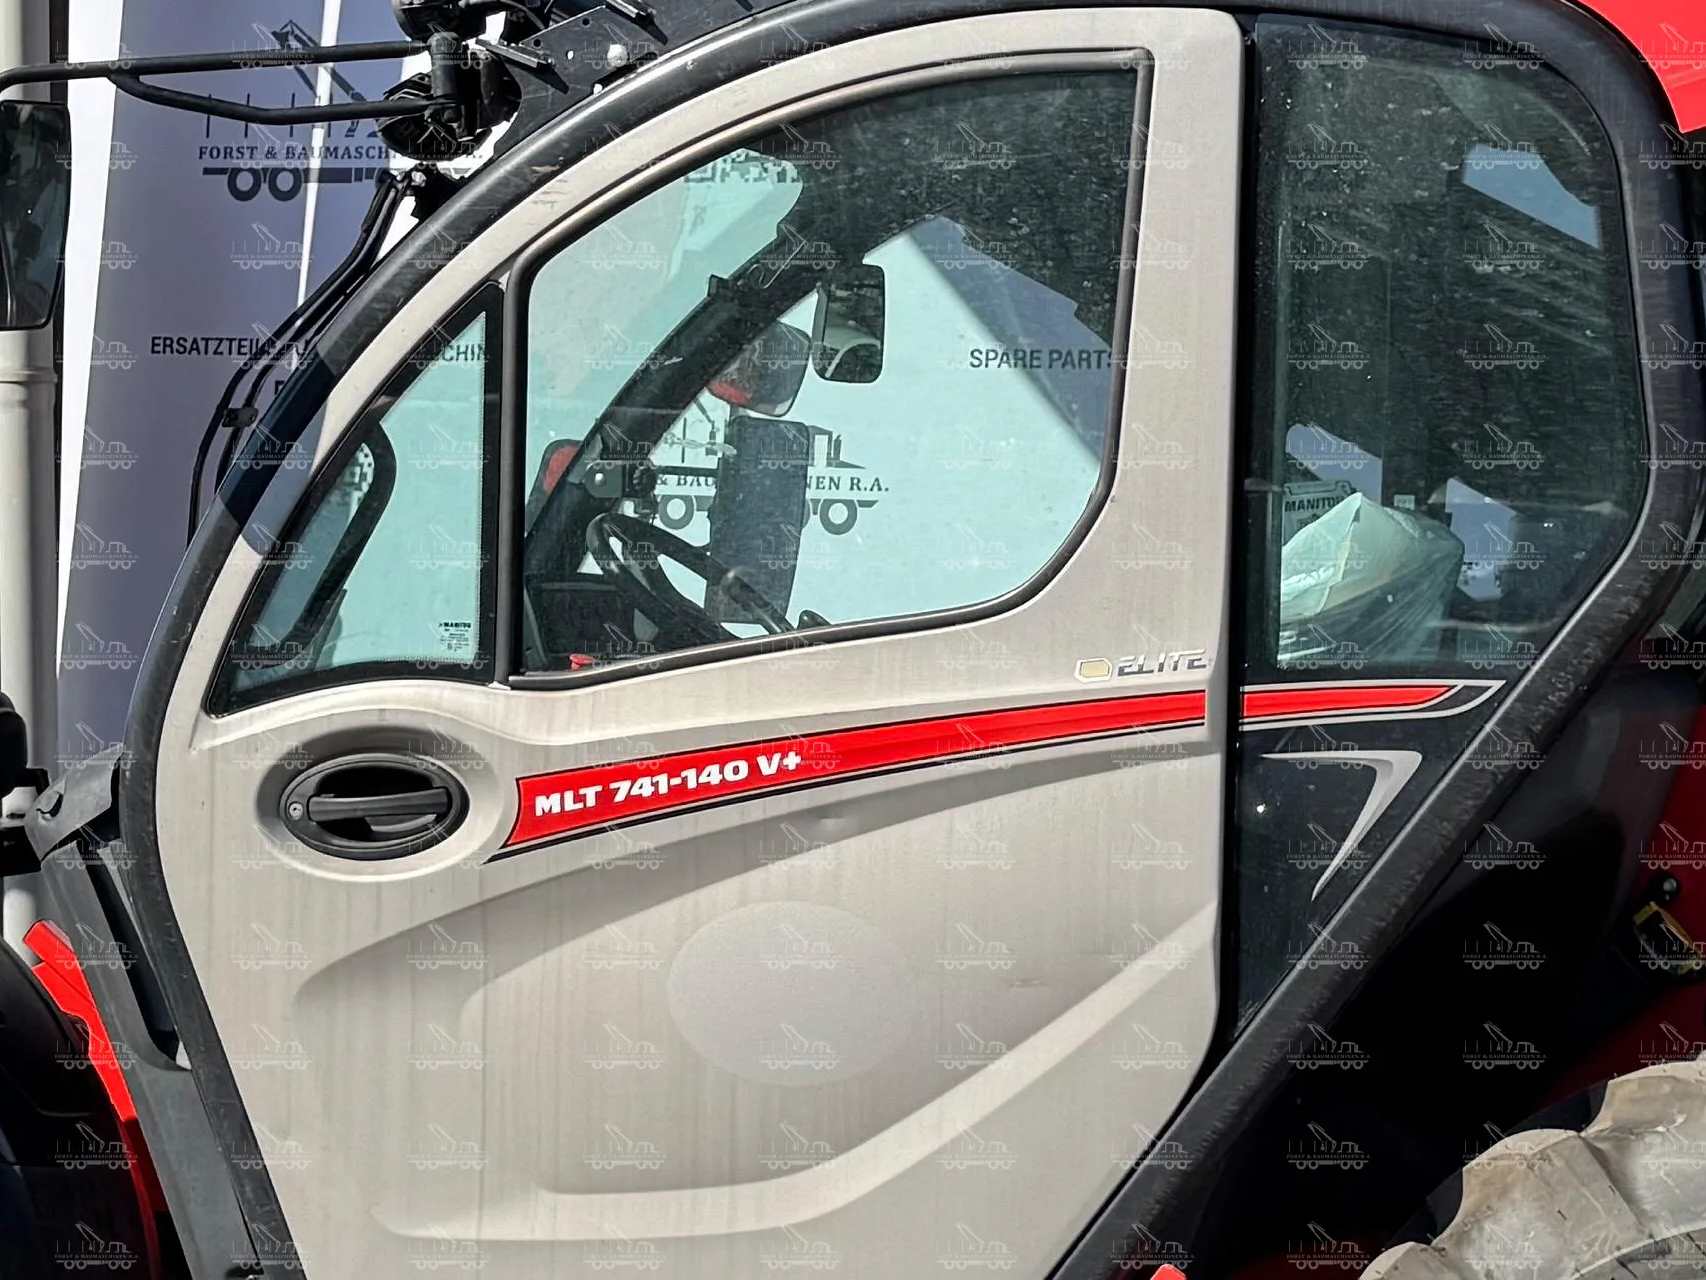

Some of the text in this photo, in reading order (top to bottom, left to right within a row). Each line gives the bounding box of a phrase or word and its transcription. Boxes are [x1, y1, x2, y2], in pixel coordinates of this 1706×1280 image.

[198, 144, 389, 161] FORST & BAUMASCH
[969, 348, 1042, 369] SPARE
[848, 476, 890, 493] R.A.
[1117, 648, 1207, 677] ELITE
[534, 751, 803, 817] MLT 741-140 V+
